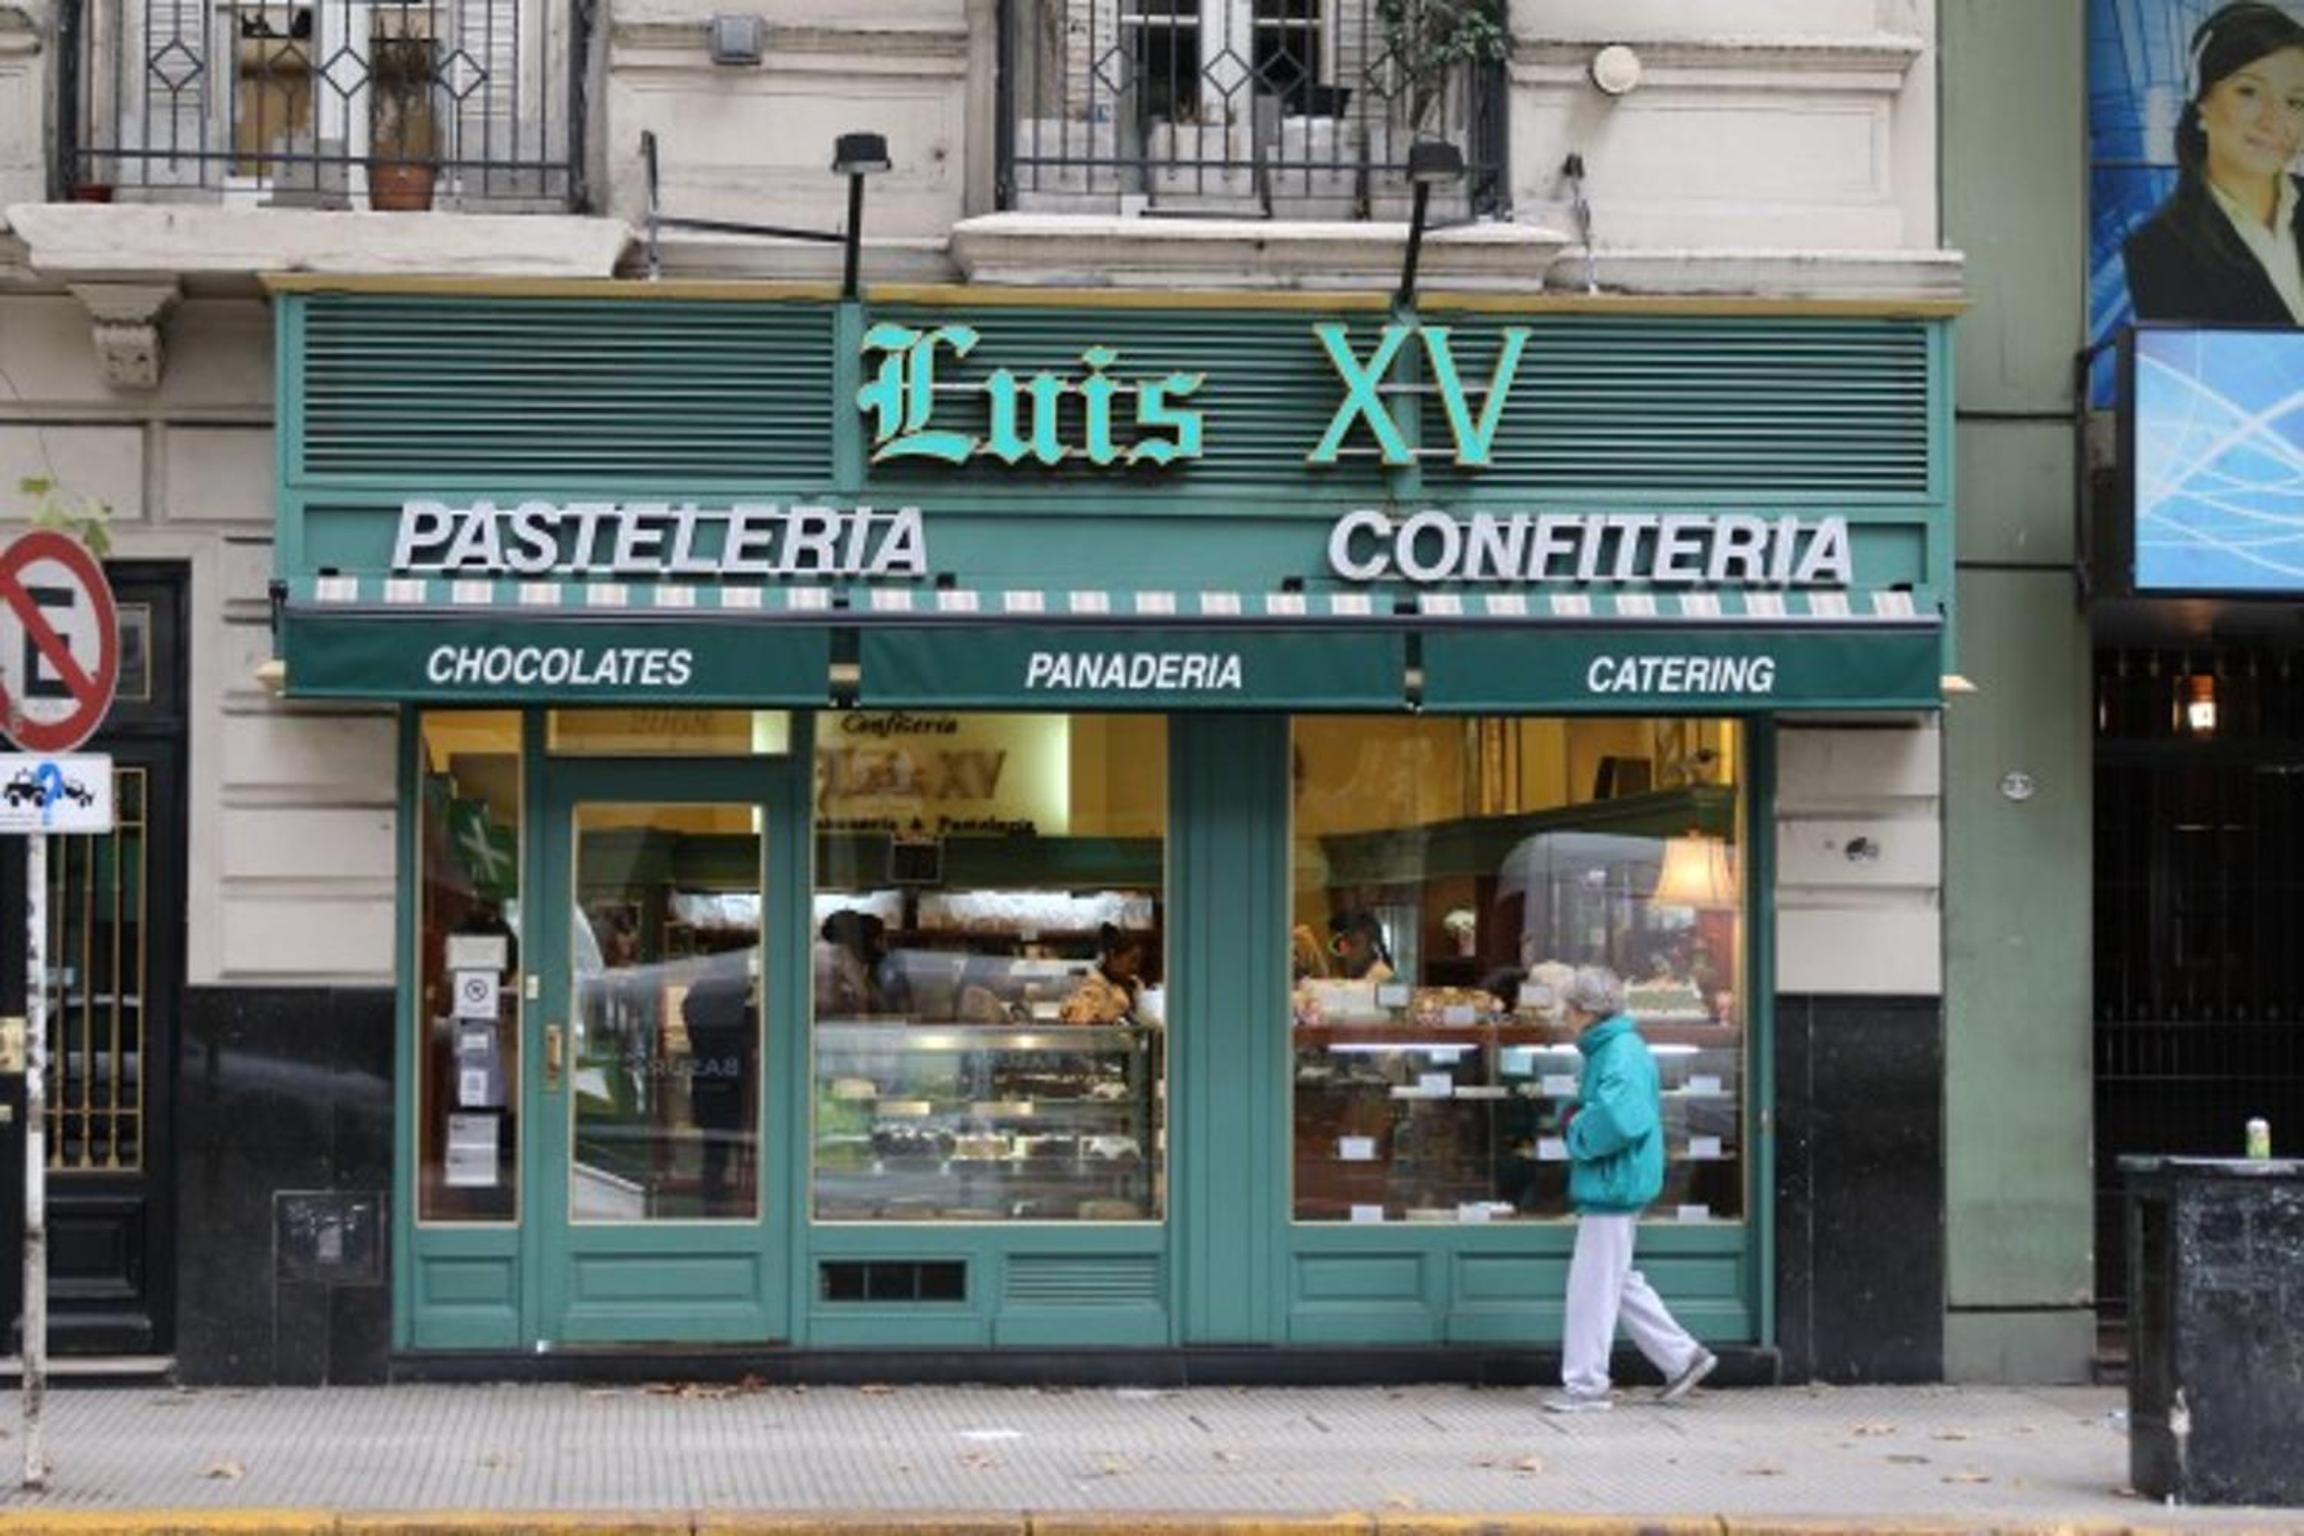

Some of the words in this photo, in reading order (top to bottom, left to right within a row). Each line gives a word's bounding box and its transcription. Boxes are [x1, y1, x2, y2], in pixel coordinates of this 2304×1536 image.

[857, 324, 1206, 465] Luis
[1306, 324, 1532, 466] XV
[391, 501, 928, 577] PASTELERIA
[1328, 508, 1854, 586] CONFITERIA
[426, 645, 694, 686] CHOCOLATES
[1025, 652, 1244, 691] PANADERIA
[1587, 655, 1776, 694] CATERING
